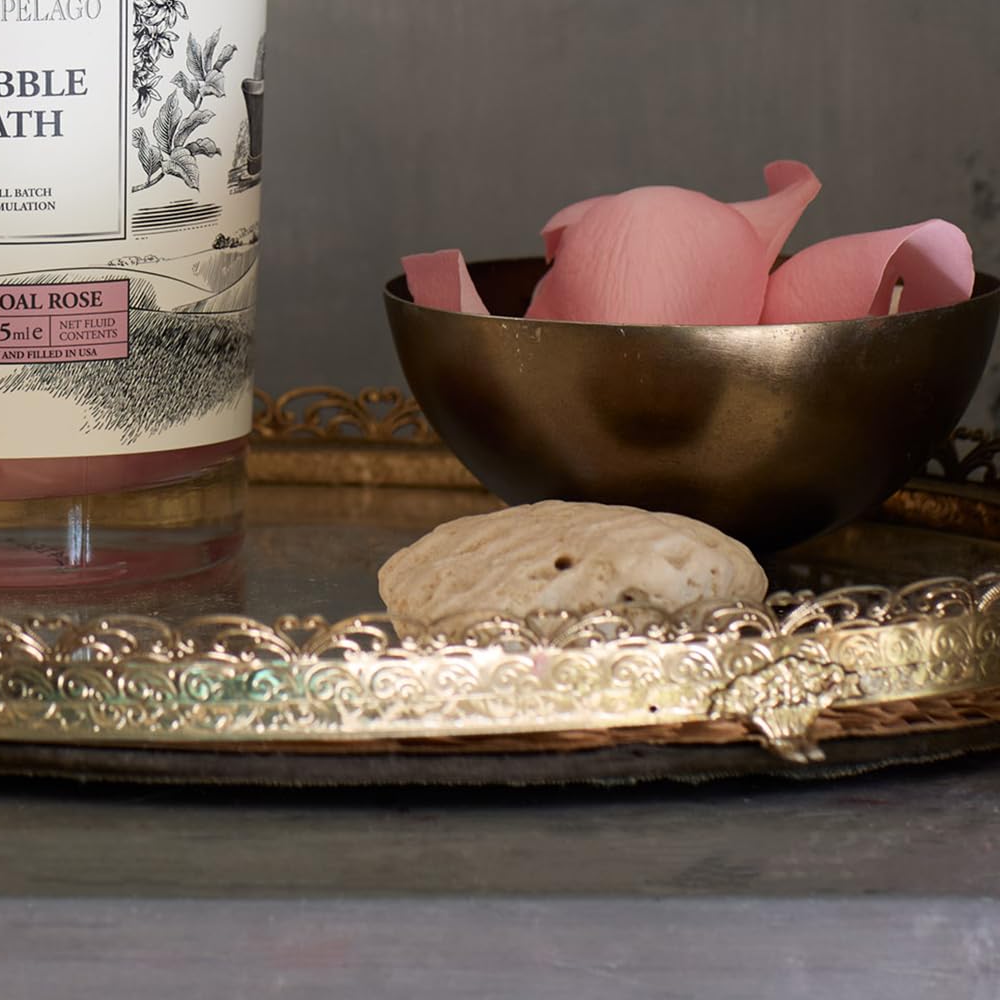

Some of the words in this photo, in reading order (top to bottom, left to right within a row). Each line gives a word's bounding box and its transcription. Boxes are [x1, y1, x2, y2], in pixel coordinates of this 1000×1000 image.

[14, 187, 52, 198] BATCH
[48, 290, 103, 310] ROSE
[59, 319, 83, 330] NET
[84, 317, 116, 330] FLUID
[59, 329, 118, 342] CONTENTS
[1, 350, 25, 360] AND
[26, 349, 62, 360] FILLED
[65, 348, 77, 359] IN
[78, 347, 98, 357] USA
